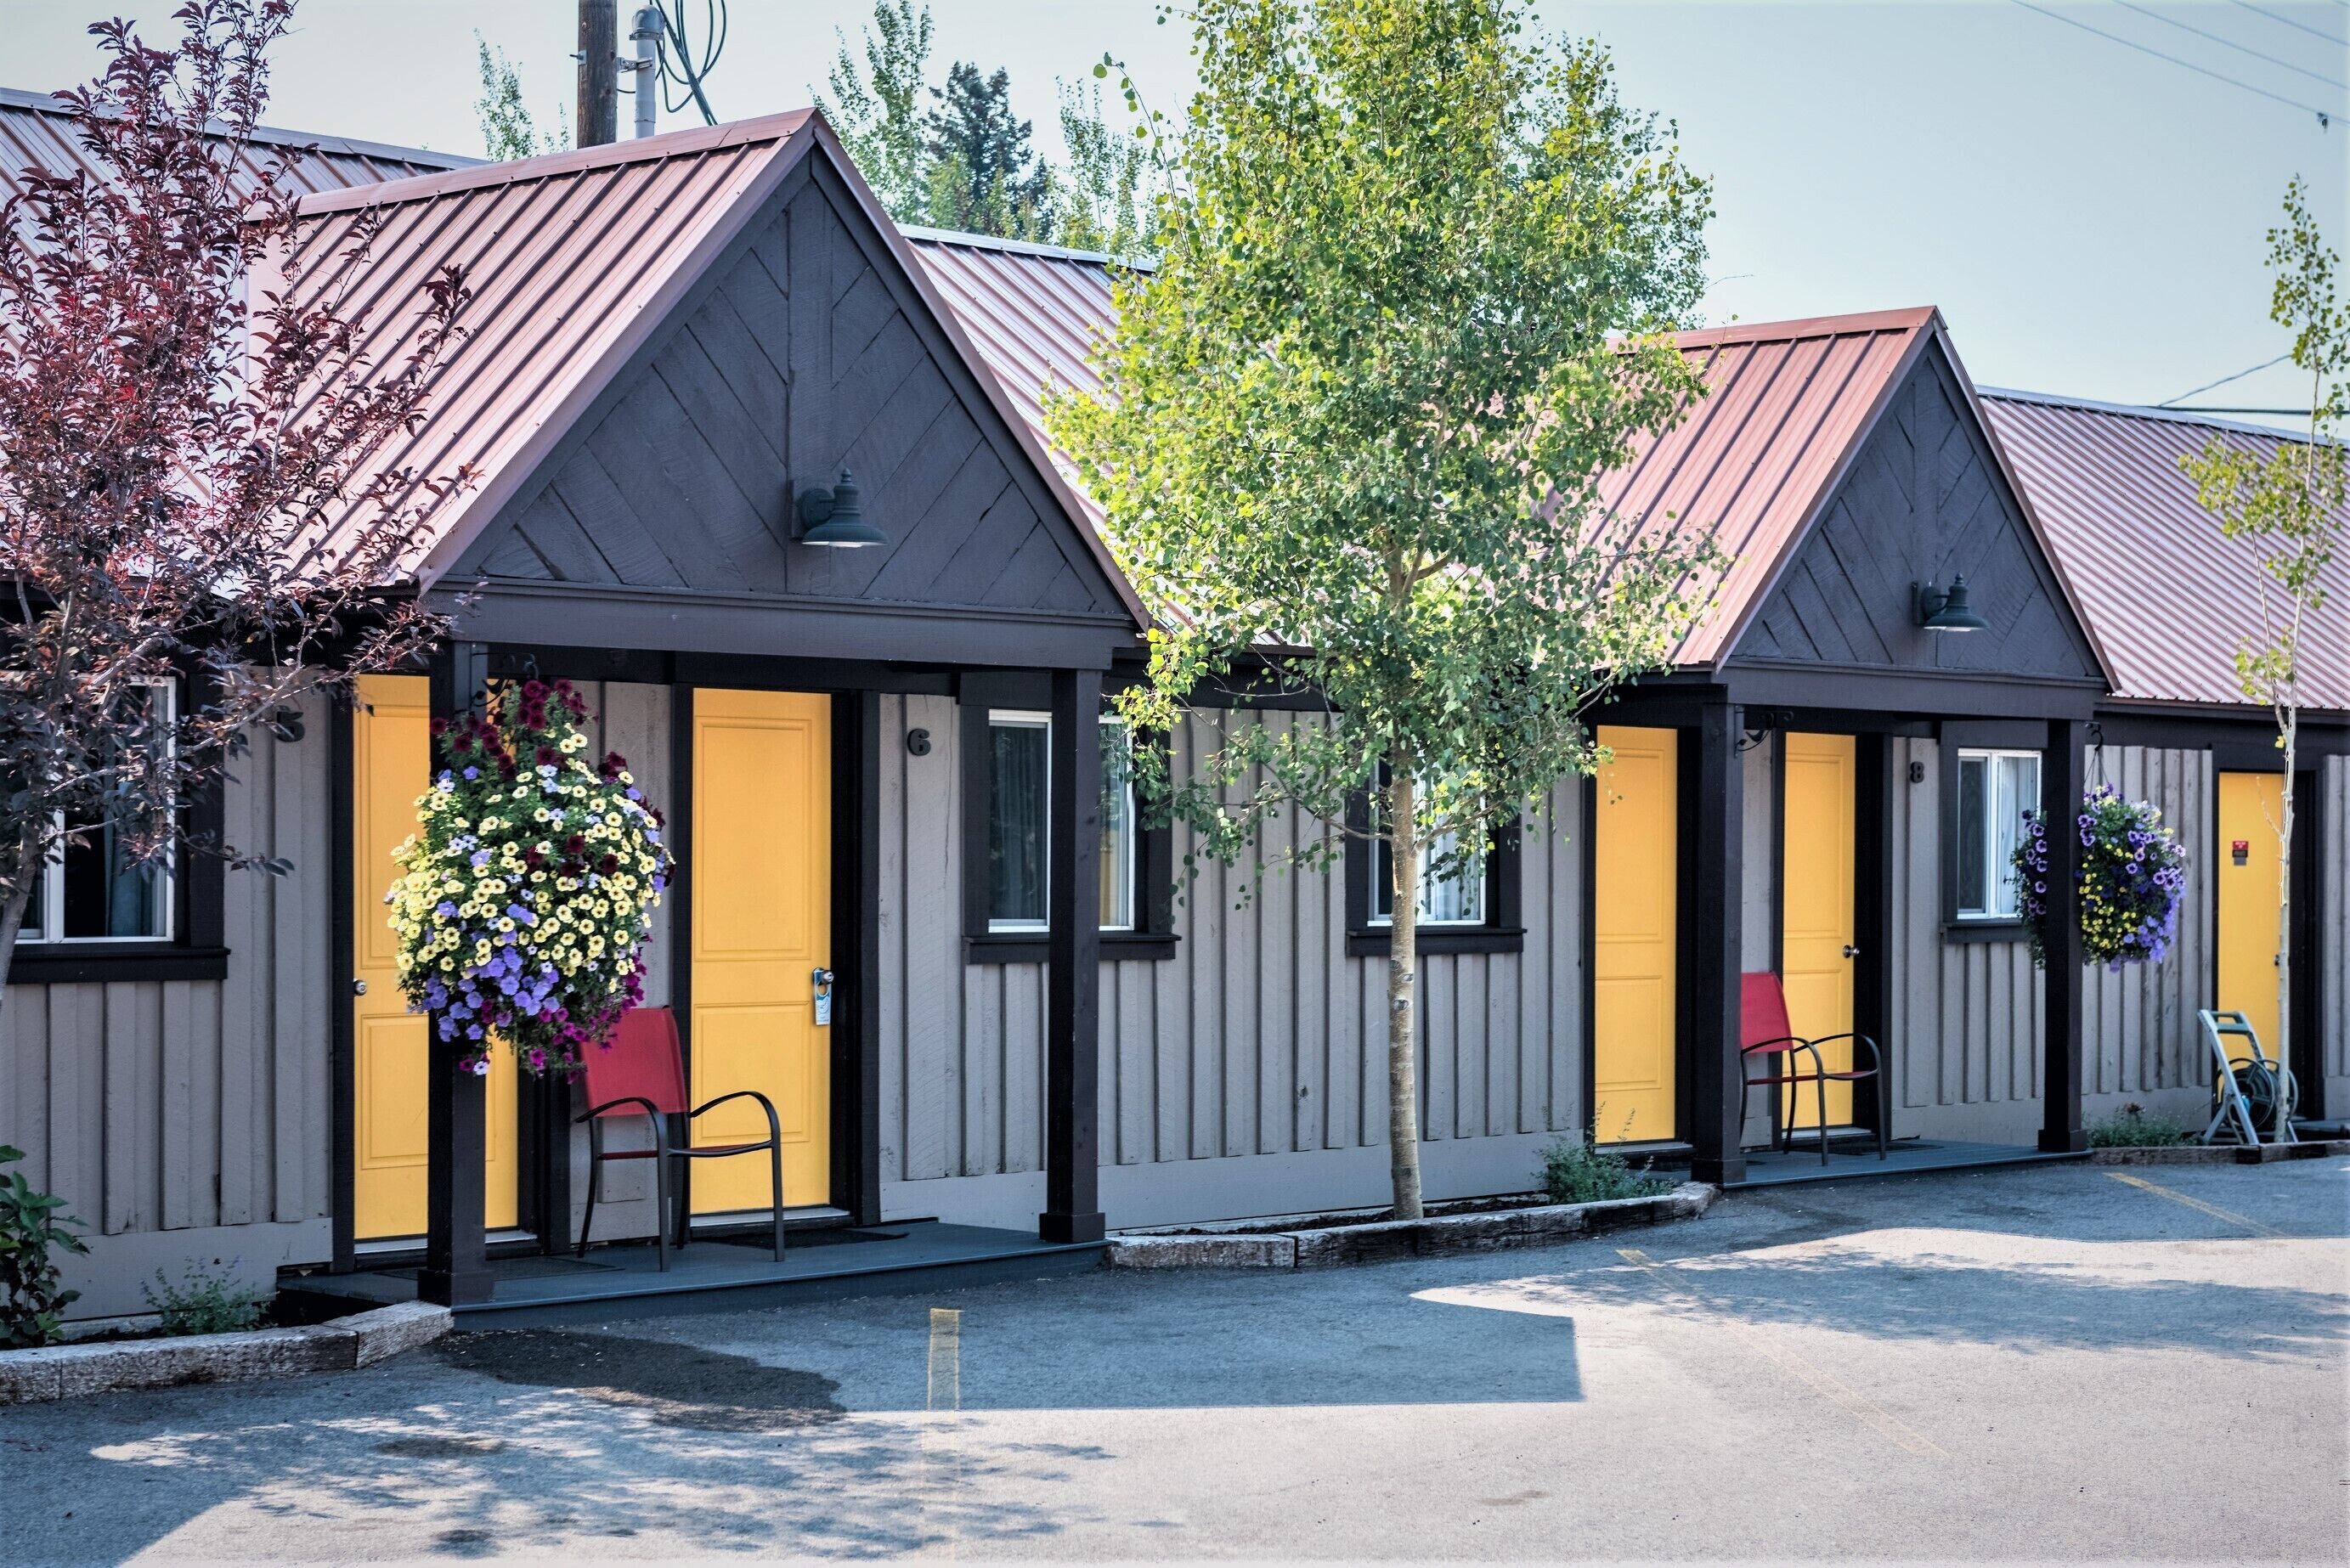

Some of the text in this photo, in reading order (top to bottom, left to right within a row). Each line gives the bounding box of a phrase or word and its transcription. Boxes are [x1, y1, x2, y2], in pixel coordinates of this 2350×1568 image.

[276, 711, 305, 742] 5
[907, 728, 931, 757] 6
[1910, 761, 1924, 783] 8
